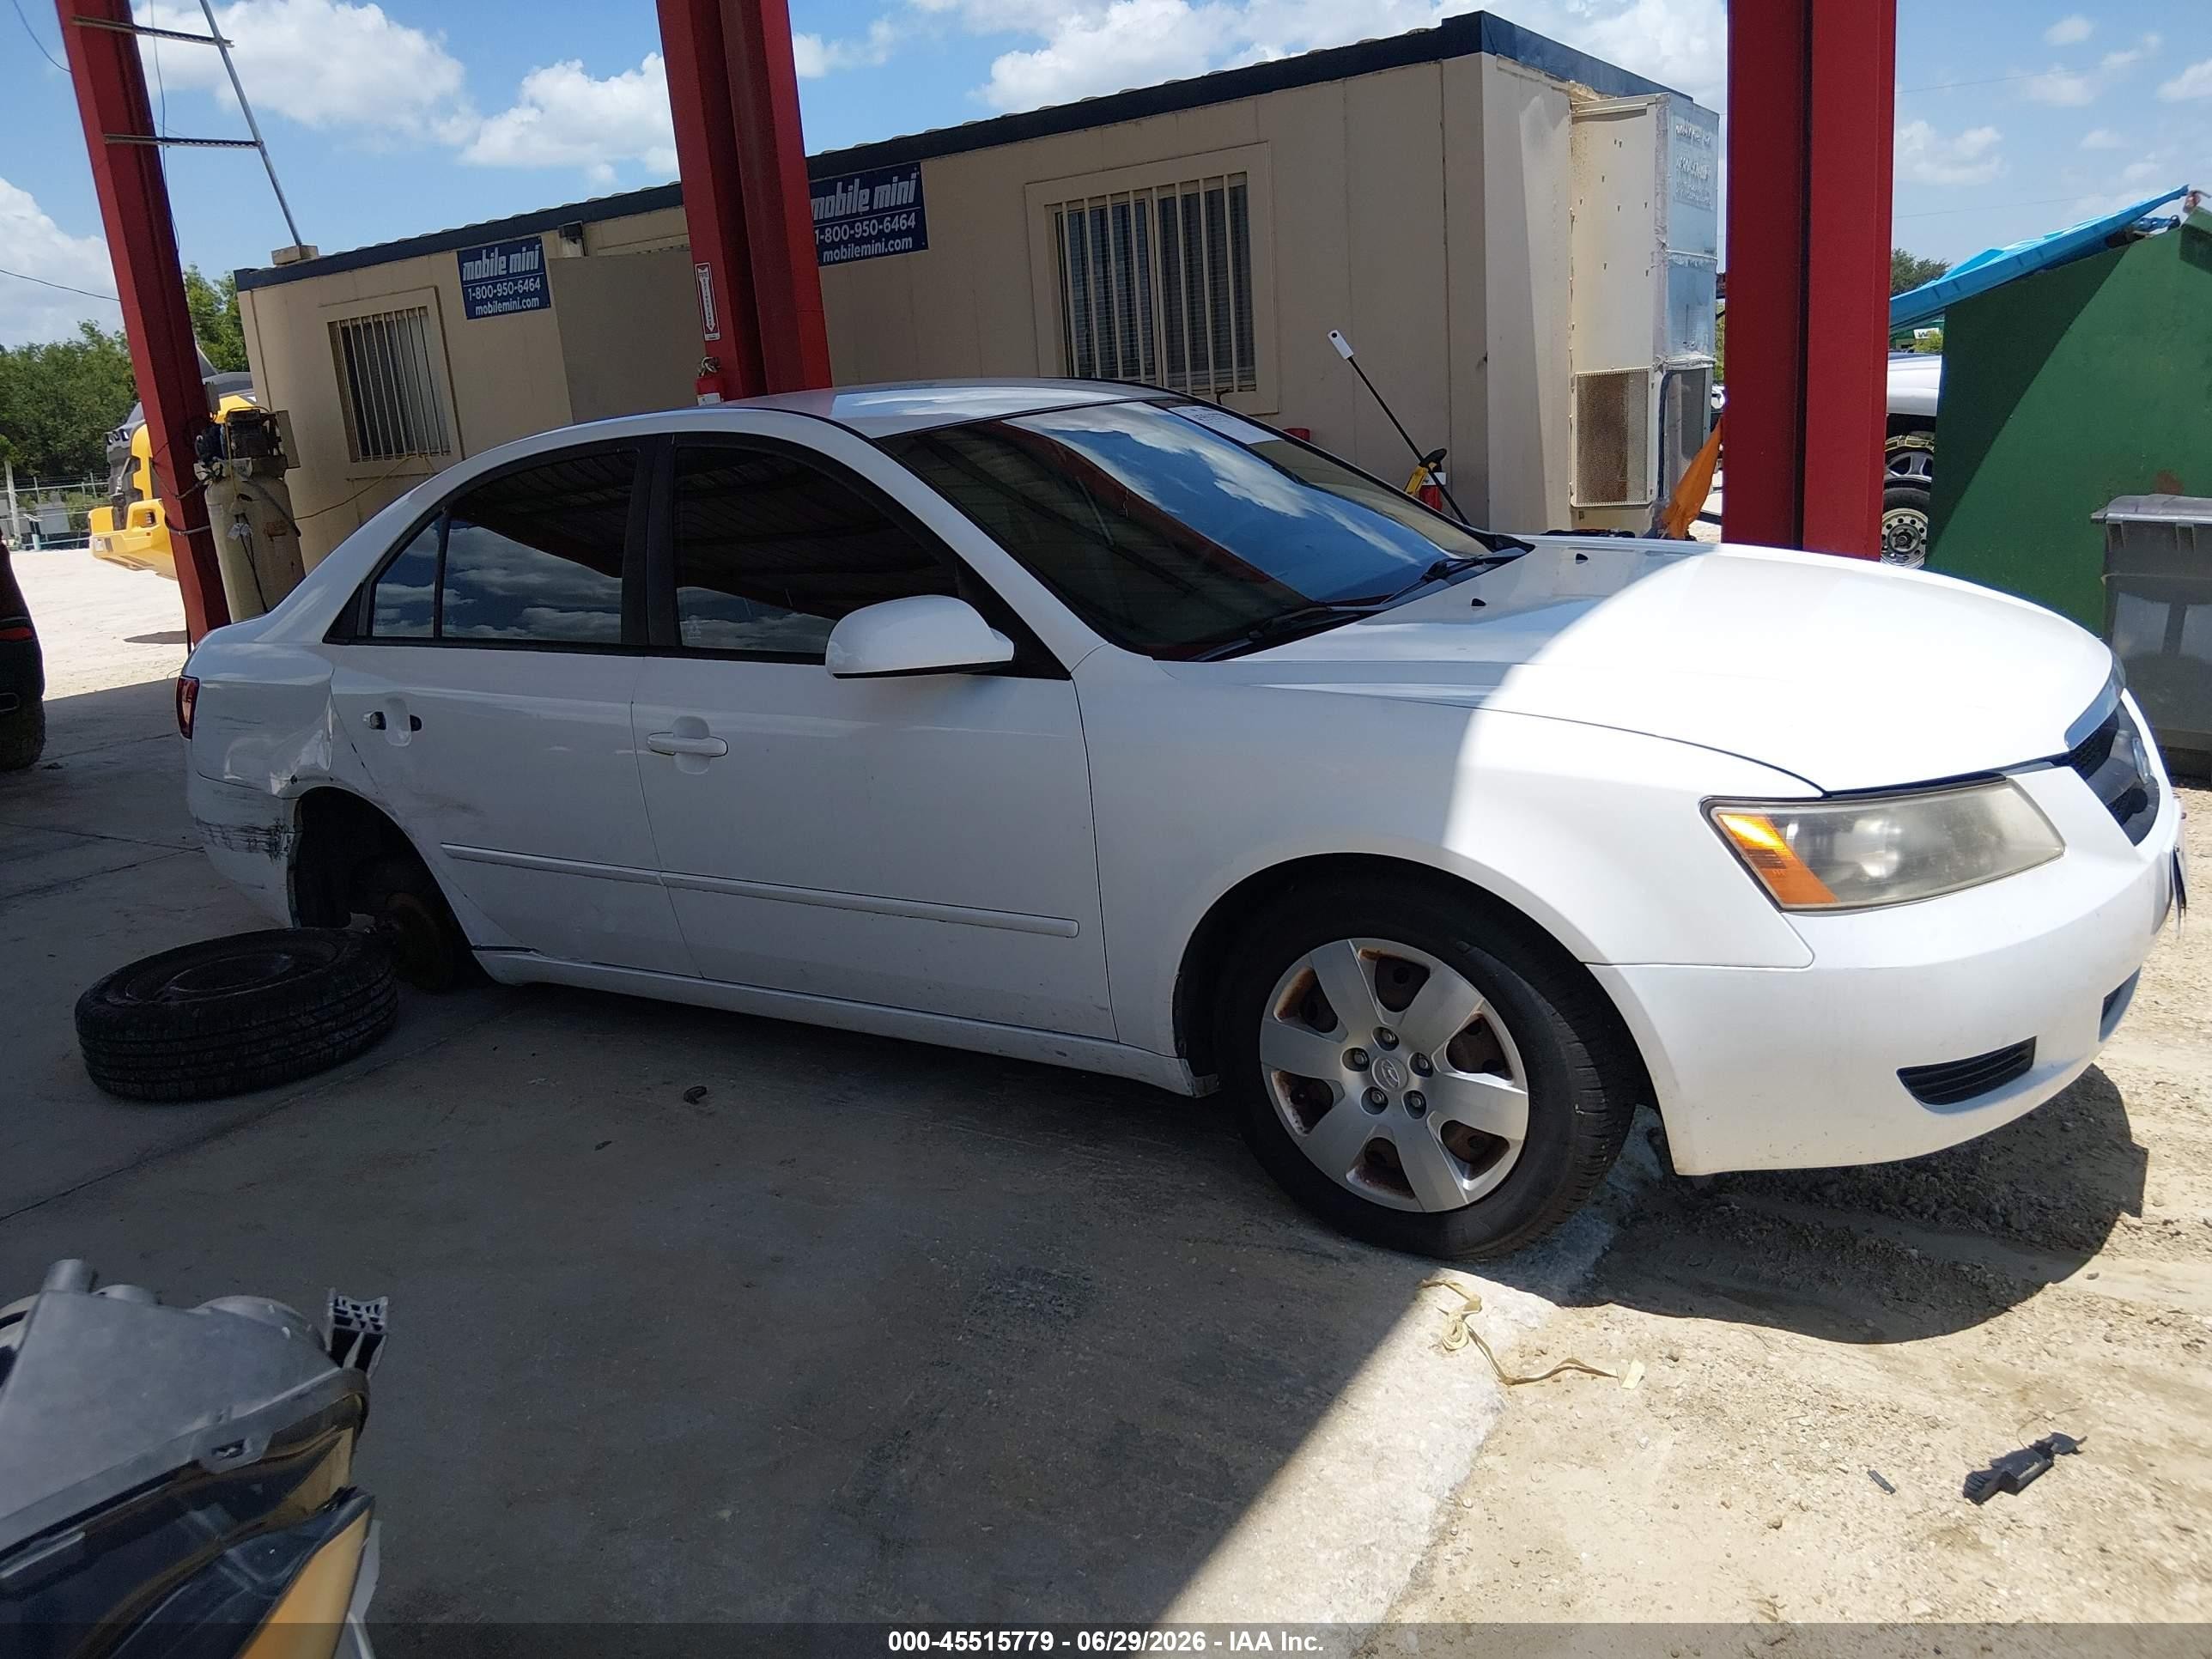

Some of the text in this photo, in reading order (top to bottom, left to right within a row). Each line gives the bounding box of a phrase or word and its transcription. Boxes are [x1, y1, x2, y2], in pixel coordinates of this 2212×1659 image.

[811, 173, 917, 221] mobile mini
[815, 212, 916, 245] 1-800-950-6464
[463, 244, 540, 281] mobile mini
[823, 237, 913, 263] mobilemini.com
[468, 276, 541, 301] 1-800-950-6464
[475, 296, 539, 316] mobilemini.com
